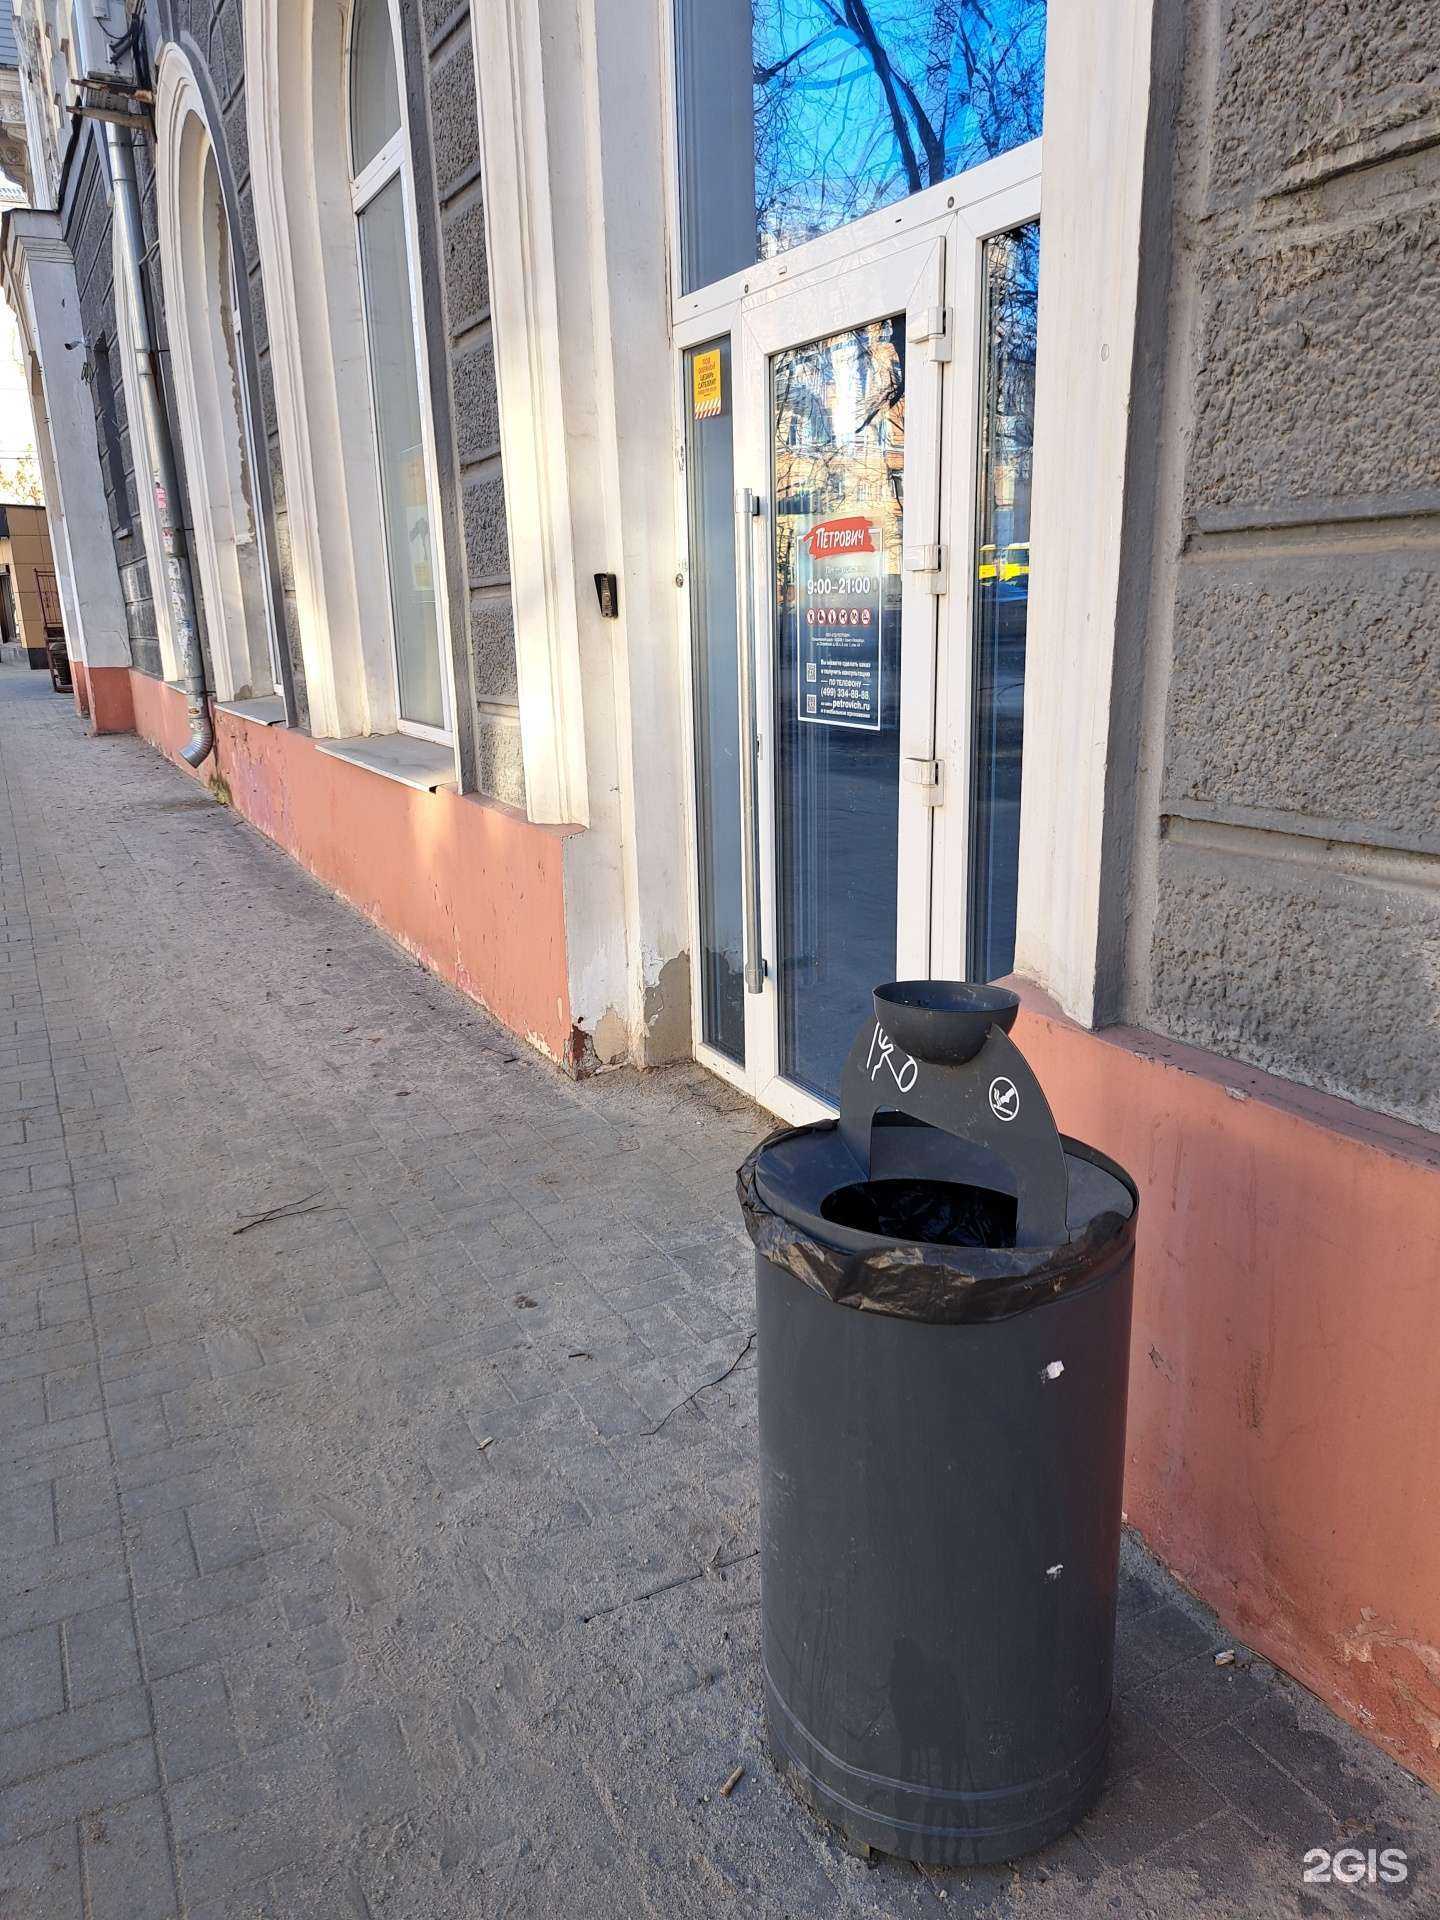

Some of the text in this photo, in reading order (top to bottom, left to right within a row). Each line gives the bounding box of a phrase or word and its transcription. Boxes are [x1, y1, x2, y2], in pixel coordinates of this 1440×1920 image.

[829, 678, 862, 688] ПО ТЕЛЕФОНУ
[832, 699, 870, 711] petrovich.ru
